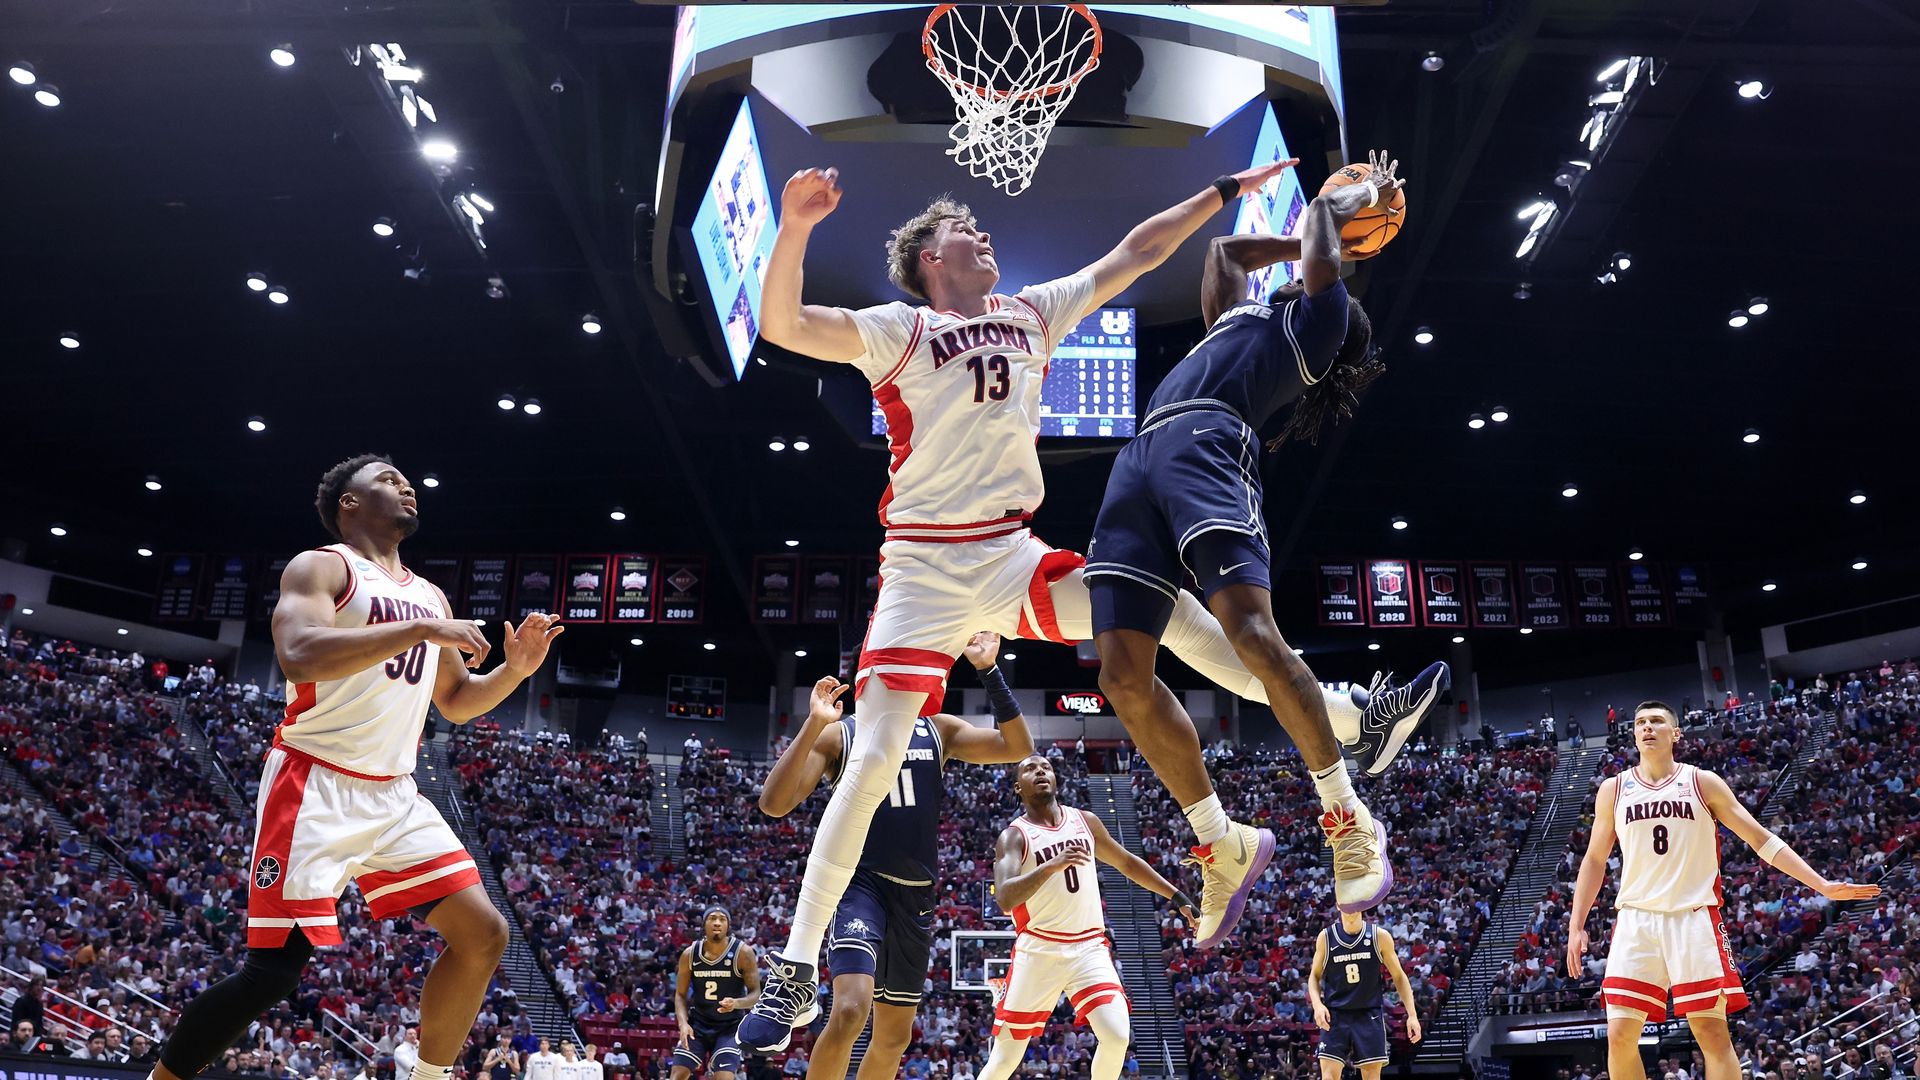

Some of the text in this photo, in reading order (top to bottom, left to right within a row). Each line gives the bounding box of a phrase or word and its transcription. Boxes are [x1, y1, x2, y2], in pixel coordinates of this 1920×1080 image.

[929, 322, 1032, 370] ARIZONA
[966, 355, 1010, 403] 13
[473, 573, 503, 582] WAC
[366, 596, 439, 626] ARIZON
[762, 609, 786, 618] 2010
[815, 610, 836, 618] 2011
[1329, 612, 1353, 620] 2018
[1379, 613, 1405, 621] 2020
[1434, 613, 1457, 622] 2021
[1483, 614, 1506, 622] 2021
[1533, 615, 1558, 624] 2023
[1585, 614, 1610, 623] 2023
[1635, 613, 1661, 622] 2024
[385, 640, 427, 685] 30
[1061, 695, 1098, 709] VIEJAS
[905, 749, 934, 761] TATE
[1625, 801, 1695, 825] ARIZONA
[1653, 824, 1669, 855] 8
[1064, 864, 1079, 894] 0
[1345, 963, 1360, 984] 8
[705, 981, 718, 1000] 2
